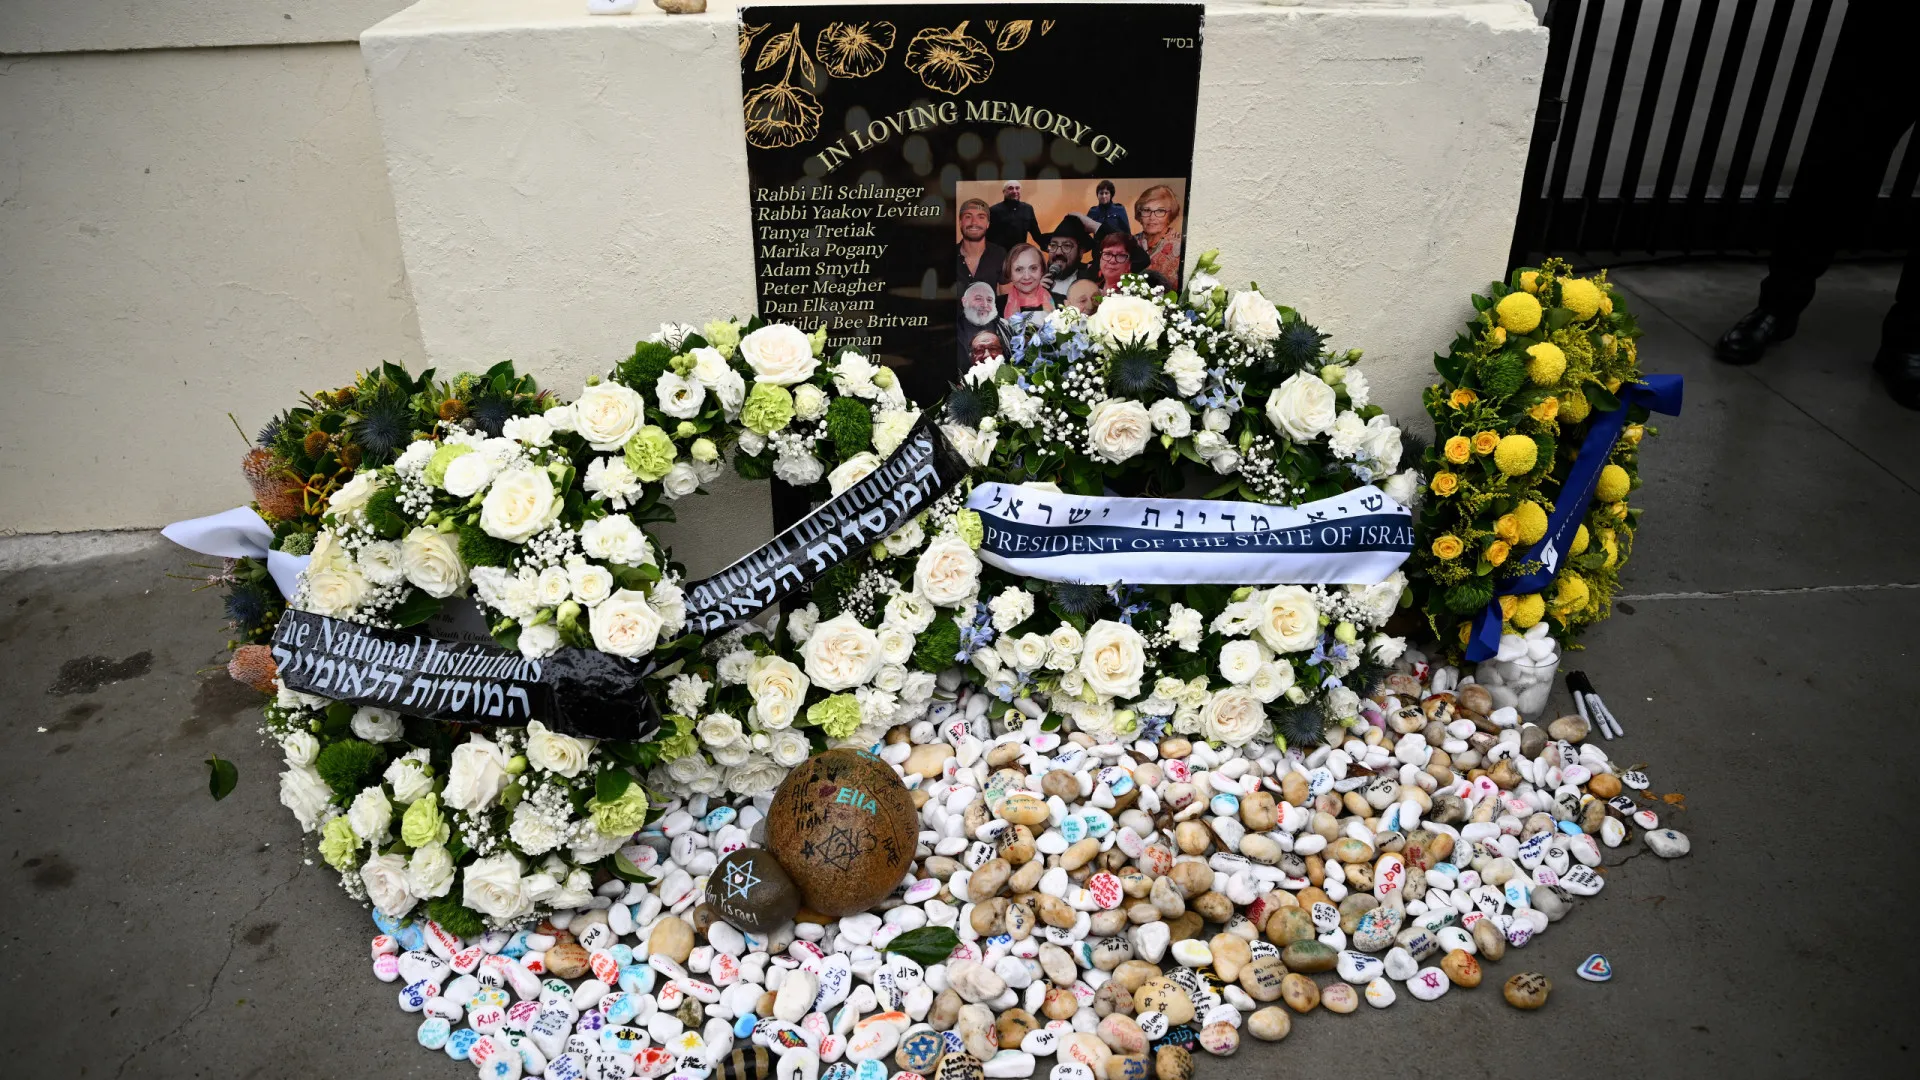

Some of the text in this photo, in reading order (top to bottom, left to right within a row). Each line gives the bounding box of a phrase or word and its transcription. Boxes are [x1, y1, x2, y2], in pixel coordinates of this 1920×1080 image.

[816, 100, 1129, 172] IN LOVING MEMORY OF
[756, 184, 924, 203] Rabbi Eli Schlanger
[757, 202, 941, 221] Rabbi Yaakov Levitan
[759, 222, 876, 242] Tanya Tretiak
[760, 243, 888, 260] Marika Pogany
[760, 260, 870, 278] Adam Smyth
[763, 278, 886, 296] Peter Meagher
[764, 298, 874, 314] Dan Elkayam
[833, 317, 863, 330] Bee
[867, 313, 929, 328] Britvan
[825, 335, 882, 348] urman
[985, 487, 1110, 525] ישראל
[1142, 506, 1271, 532] מדינת
[985, 525, 1415, 553] PRESIDENT OF THE STATE OF ISRAE
[311, 616, 421, 671] National
[420, 637, 543, 683] Institutions
[402, 675, 531, 718] המוסדות
